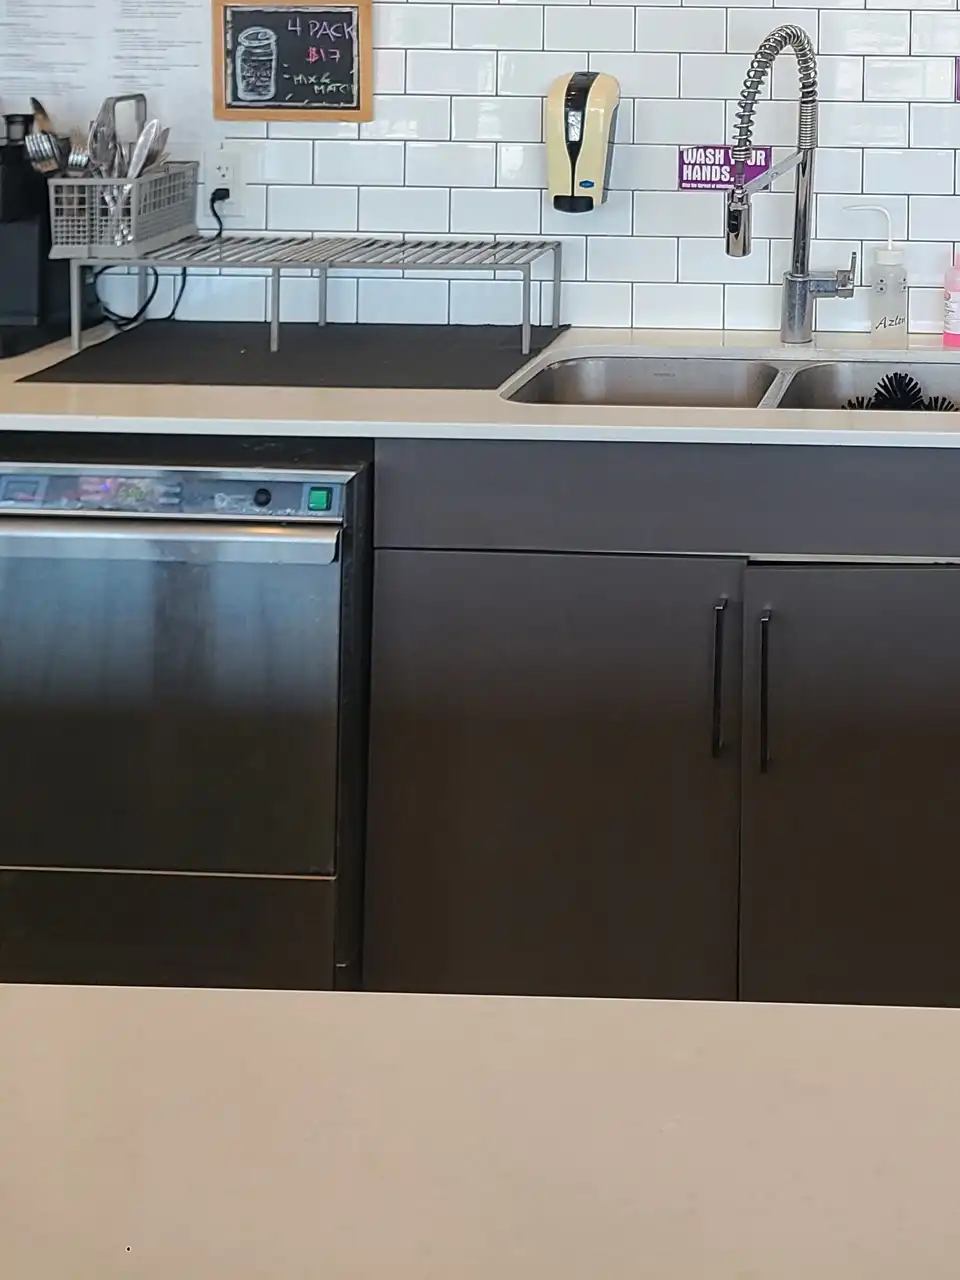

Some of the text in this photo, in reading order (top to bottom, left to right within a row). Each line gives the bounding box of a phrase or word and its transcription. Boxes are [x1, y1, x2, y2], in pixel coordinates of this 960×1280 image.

[288, 16, 354, 42] 4 PACK
[682, 148, 766, 166] WASH YUR
[682, 165, 735, 182] HANDS.
